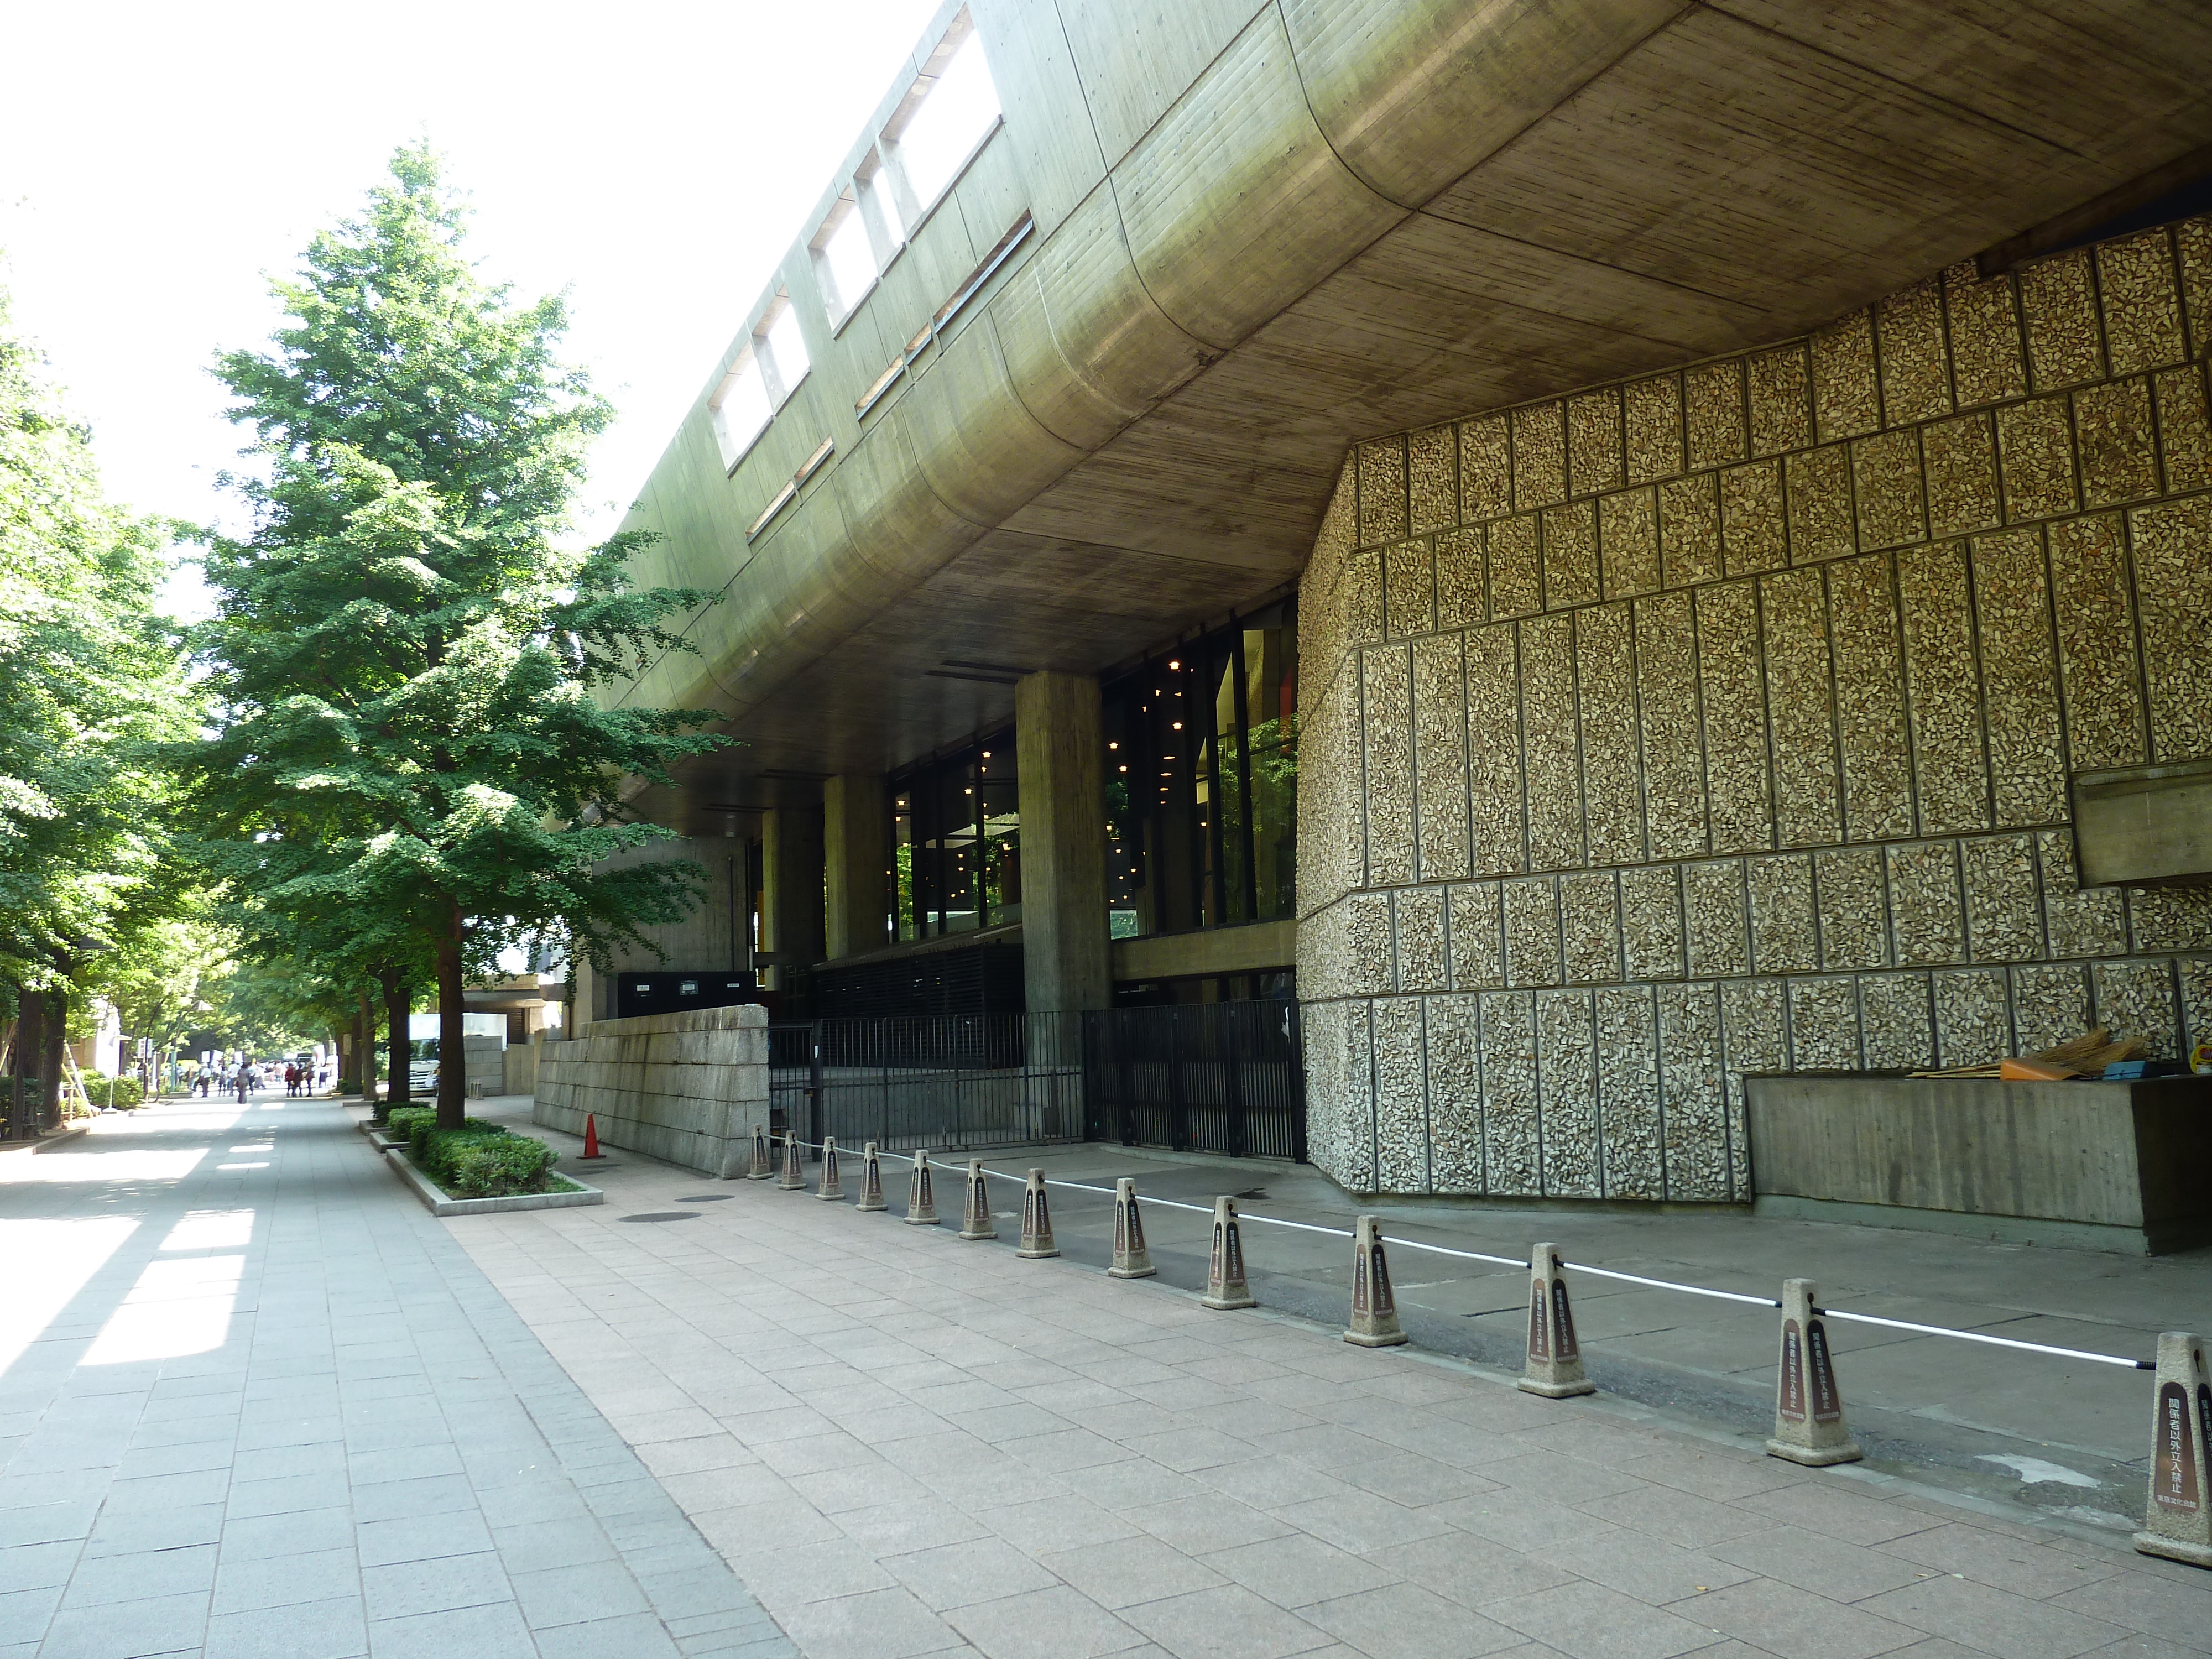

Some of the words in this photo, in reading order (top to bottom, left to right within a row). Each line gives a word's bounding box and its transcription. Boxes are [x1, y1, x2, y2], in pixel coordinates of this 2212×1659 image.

[2168, 1397, 2182, 1494] 関係者以外立入禁止
[2157, 1495, 2196, 1509] 東京文化会館
